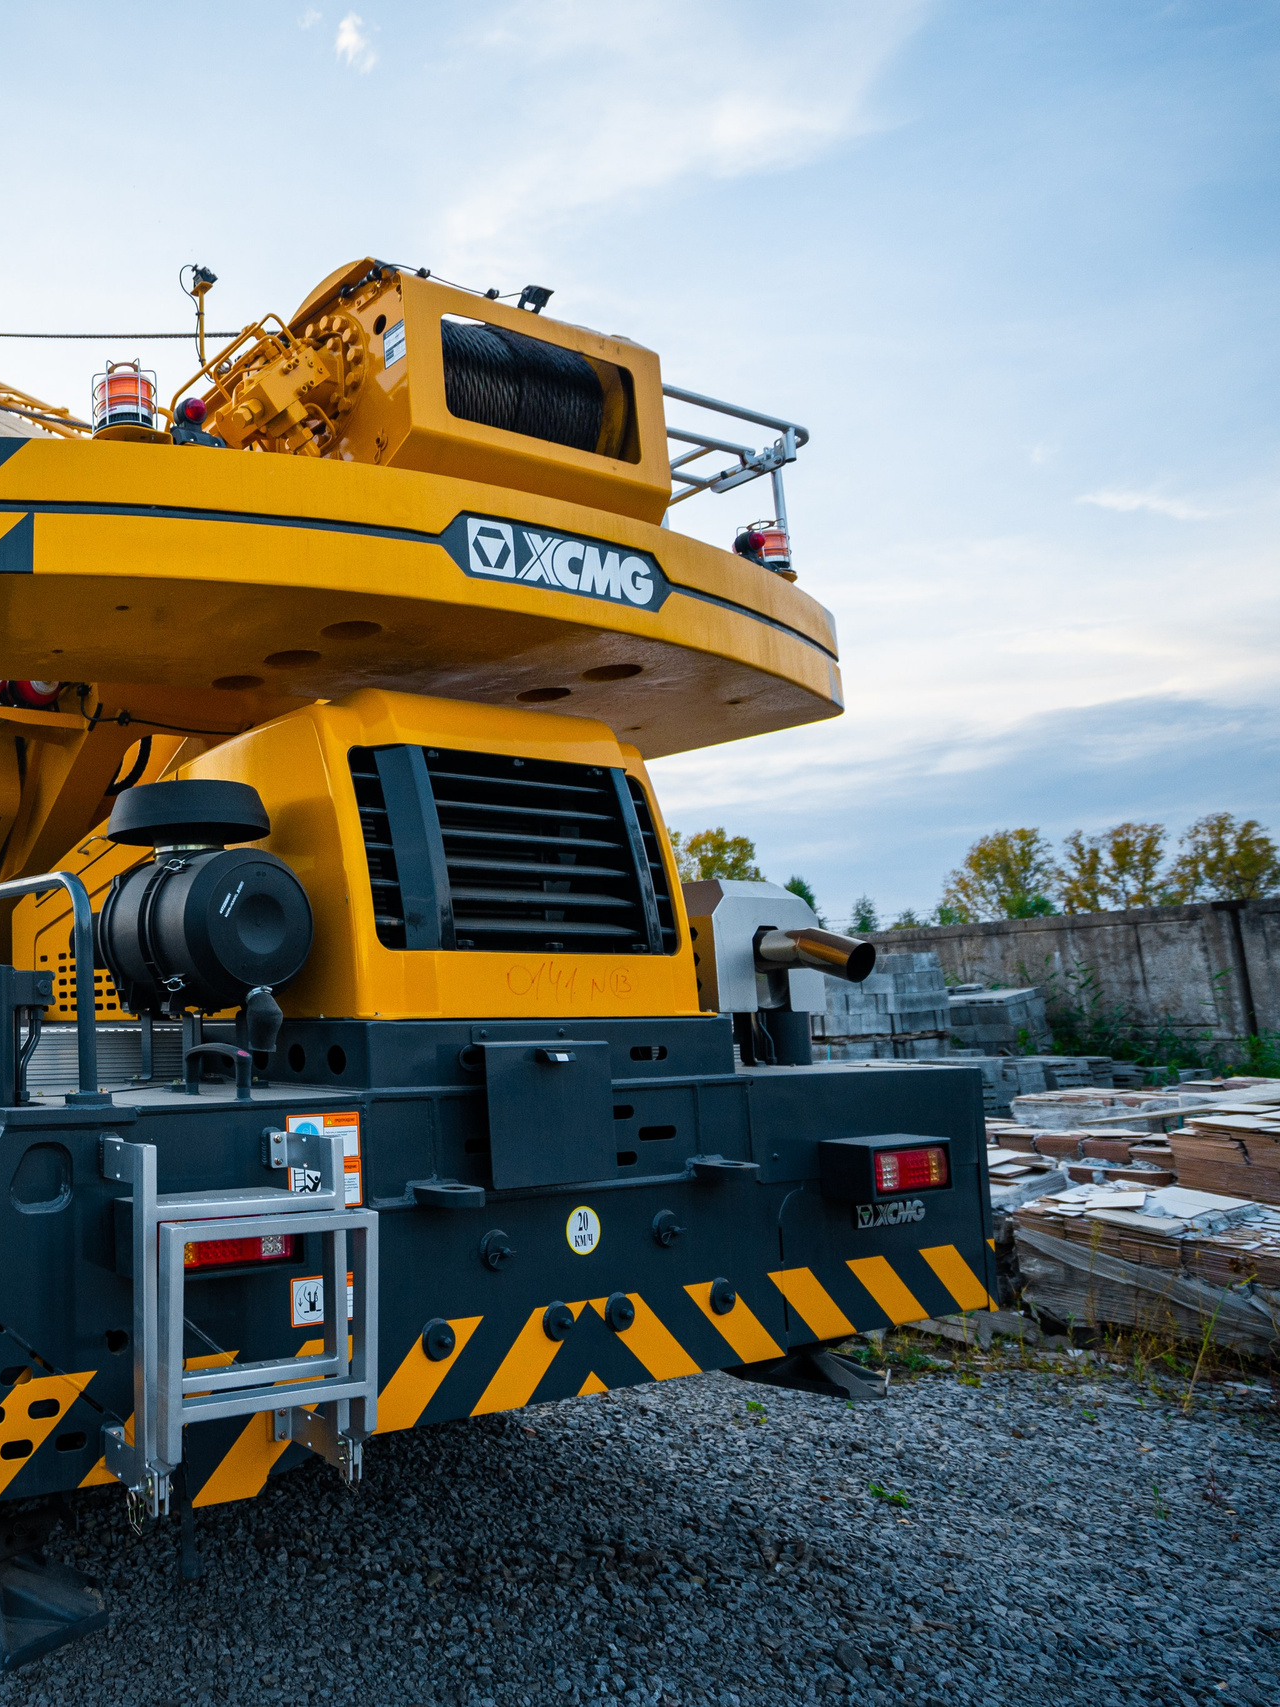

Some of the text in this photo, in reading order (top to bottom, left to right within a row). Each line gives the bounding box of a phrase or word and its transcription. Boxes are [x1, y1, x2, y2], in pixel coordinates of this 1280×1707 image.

[516, 531, 654, 606] XCMG
[577, 1211, 589, 1232] 20
[873, 1199, 926, 1228] XCMG
